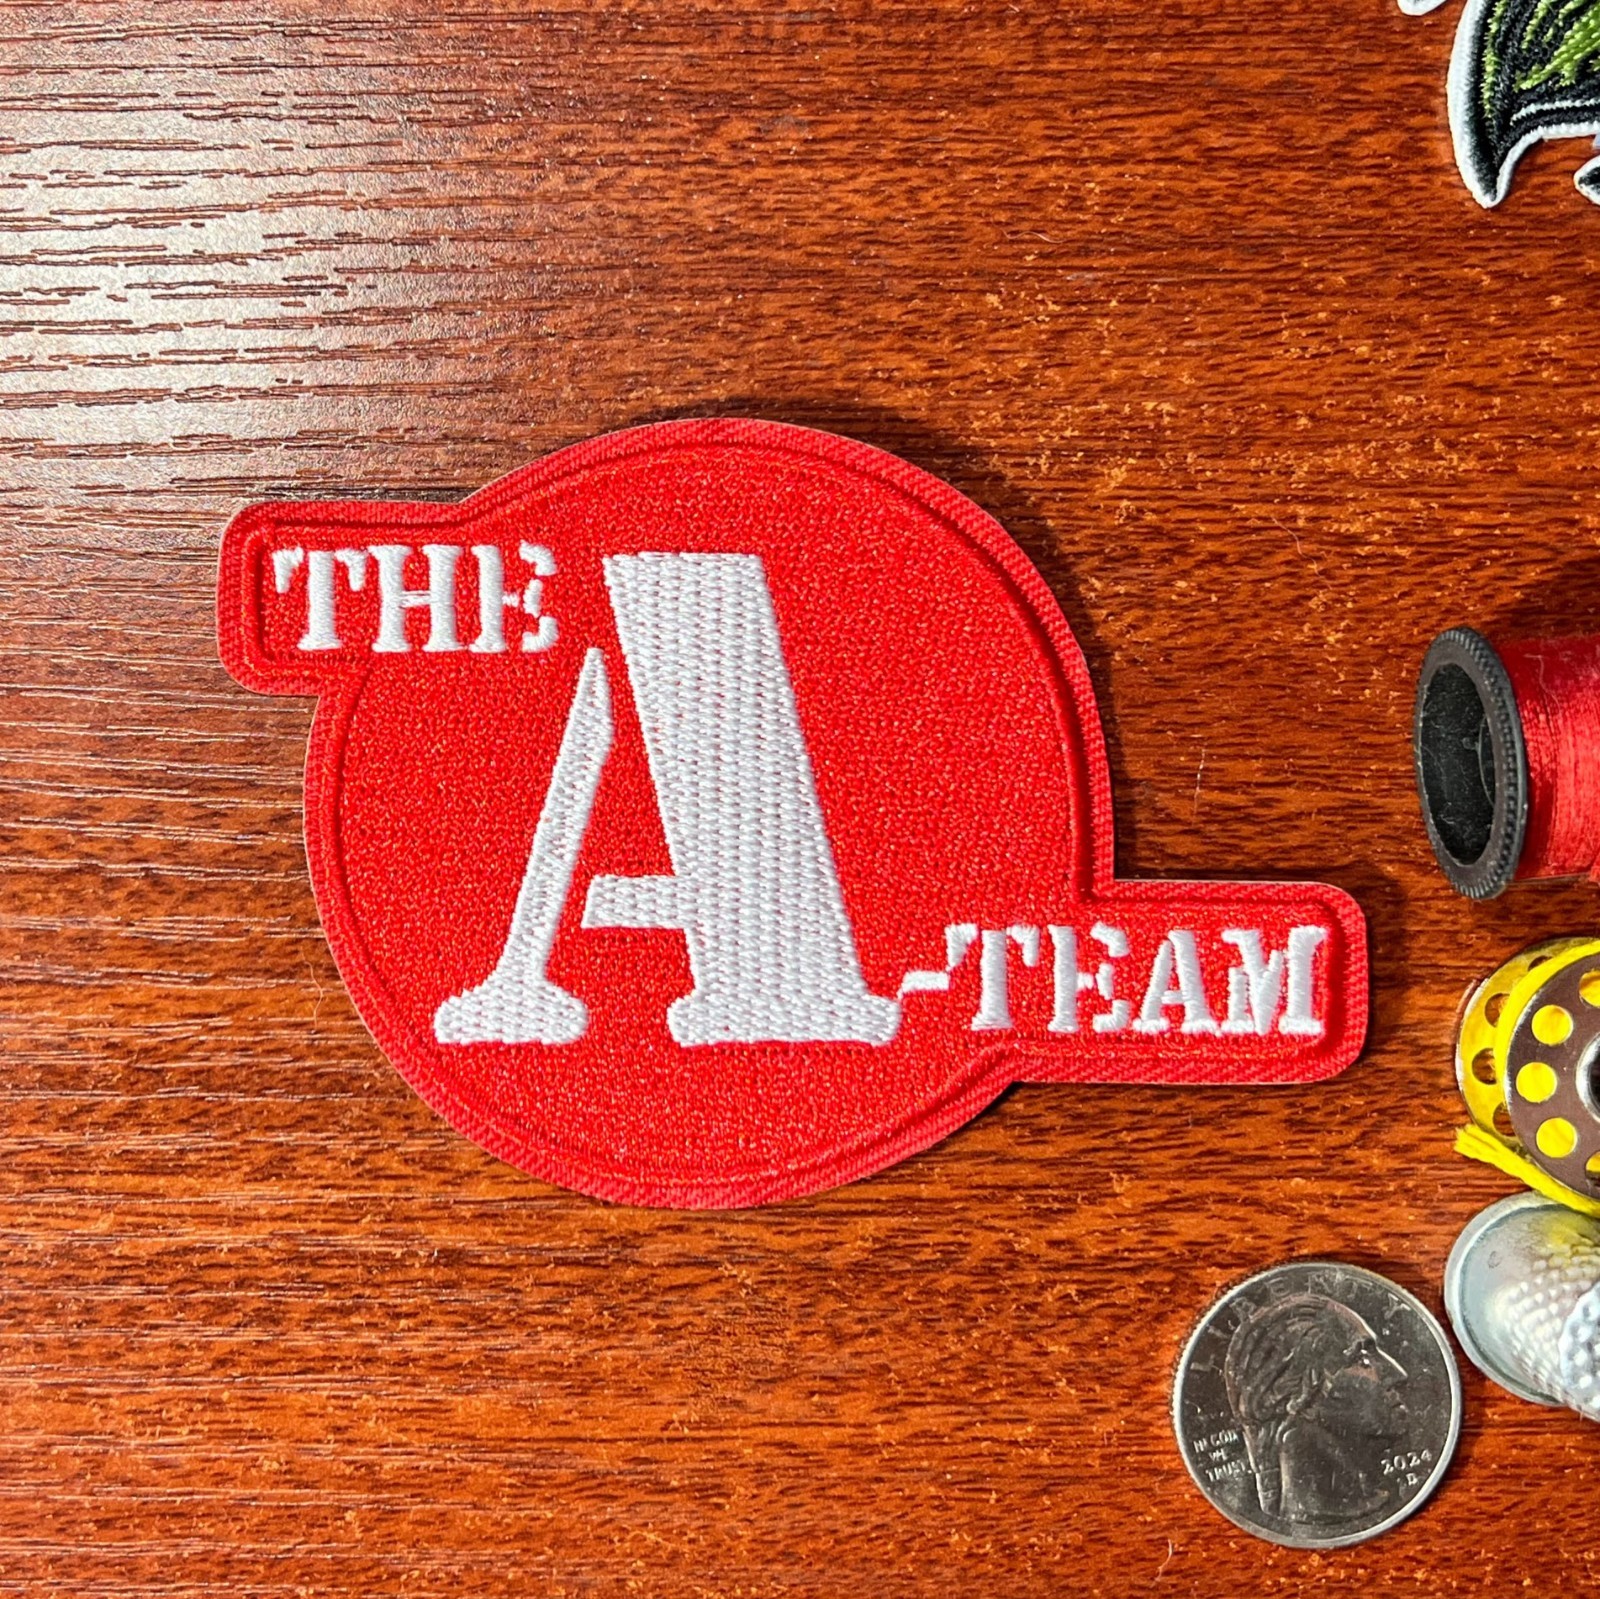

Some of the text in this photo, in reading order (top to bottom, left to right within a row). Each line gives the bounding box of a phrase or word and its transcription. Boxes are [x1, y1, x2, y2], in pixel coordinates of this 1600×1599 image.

[271, 540, 559, 653] THE
[1190, 1269, 1412, 1372] LIBERTY
[1380, 1449, 1432, 1475] 2024
